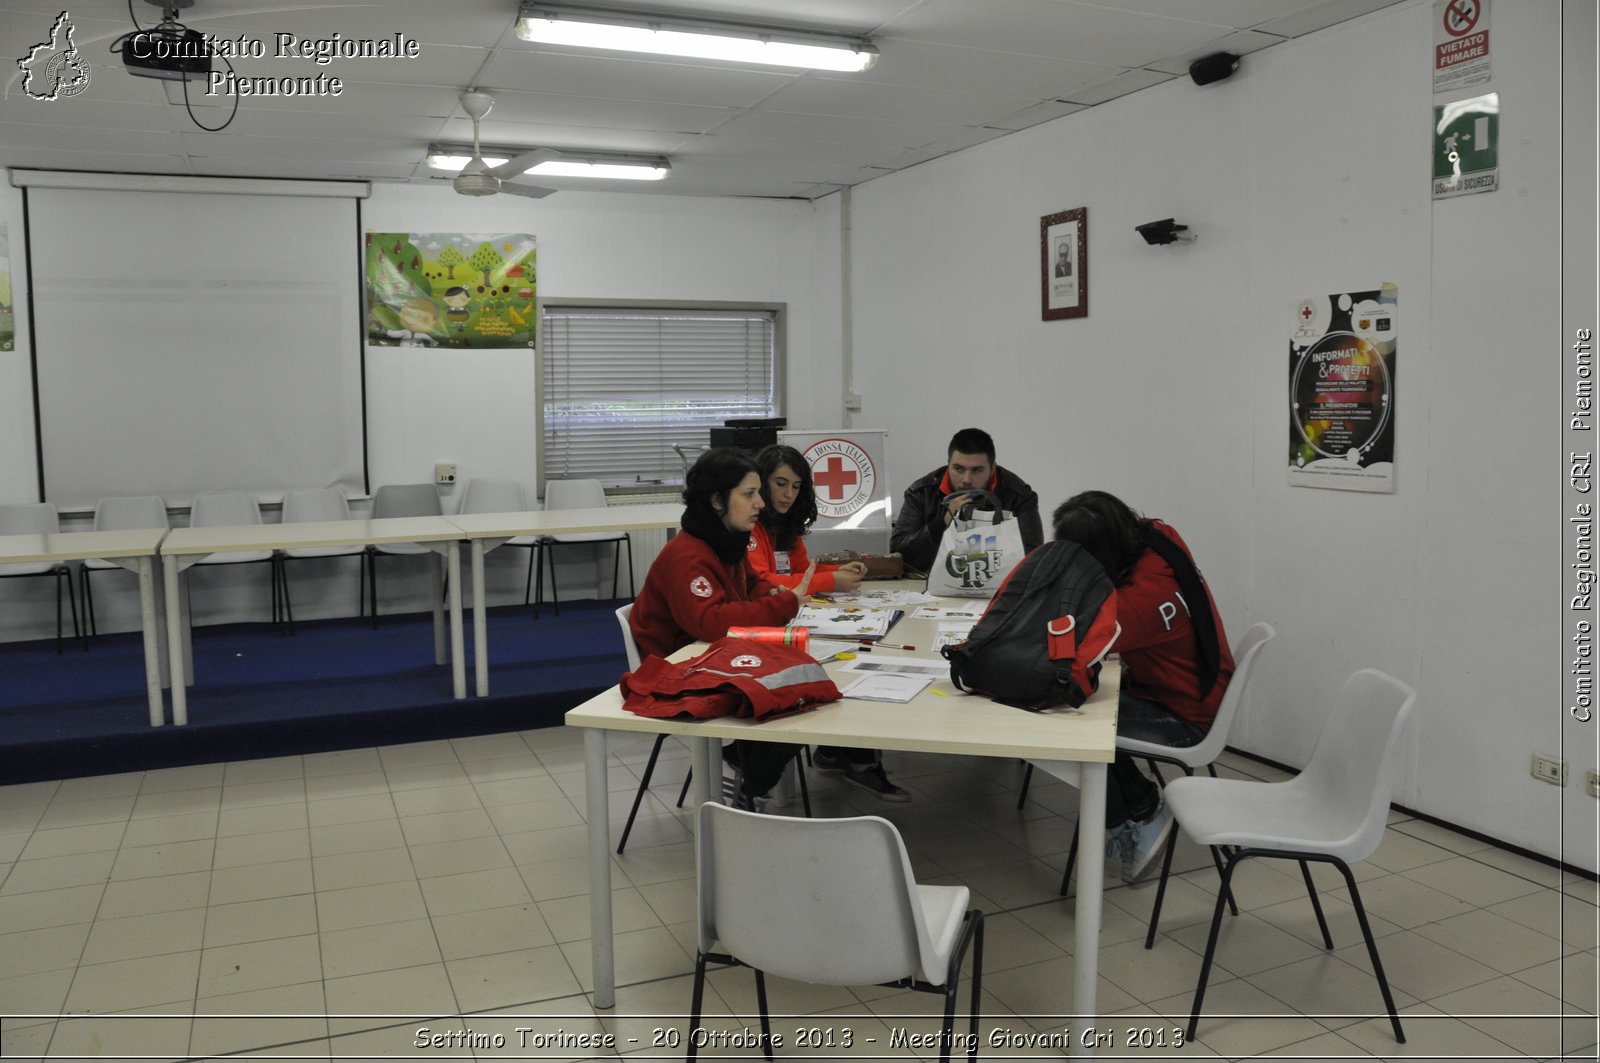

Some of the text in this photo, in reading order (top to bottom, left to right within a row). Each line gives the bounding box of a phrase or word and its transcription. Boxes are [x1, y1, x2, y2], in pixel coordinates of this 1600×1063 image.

[1440, 33, 1485, 54] VIETATO
[1440, 45, 1485, 66] FUMARE
[1464, 174, 1495, 190] SICUREZZA
[1312, 347, 1358, 363] INFORMATI
[1318, 361, 1370, 379] & PROTETTI
[813, 442, 872, 479] ROSSA ITALIANA
[834, 491, 869, 516] MILITARE
